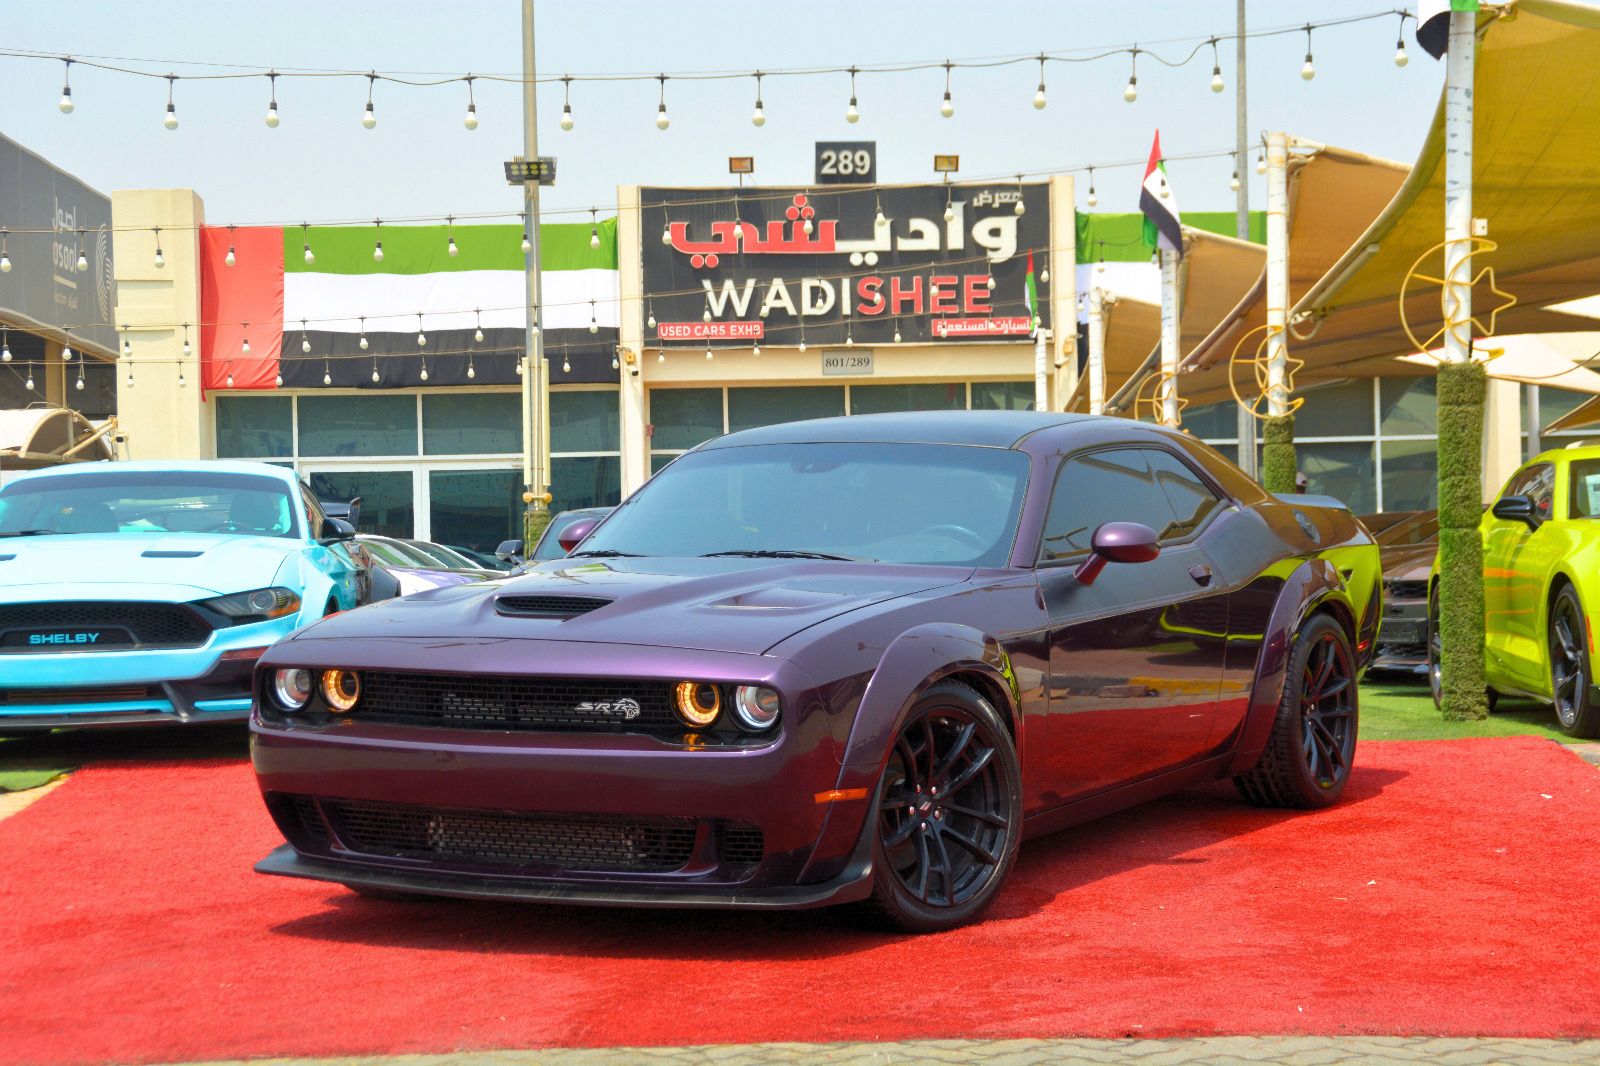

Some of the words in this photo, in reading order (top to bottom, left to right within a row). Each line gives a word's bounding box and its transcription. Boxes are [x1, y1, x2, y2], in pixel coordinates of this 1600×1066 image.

[820, 150, 871, 175] 289
[702, 275, 993, 317] WADISHEE
[661, 326, 691, 337] USED
[694, 325, 726, 336] CARS
[730, 324, 761, 336] EXHB
[825, 357, 870, 368] 801/289
[29, 632, 100, 645] SHELBY
[575, 702, 626, 713] SRT
